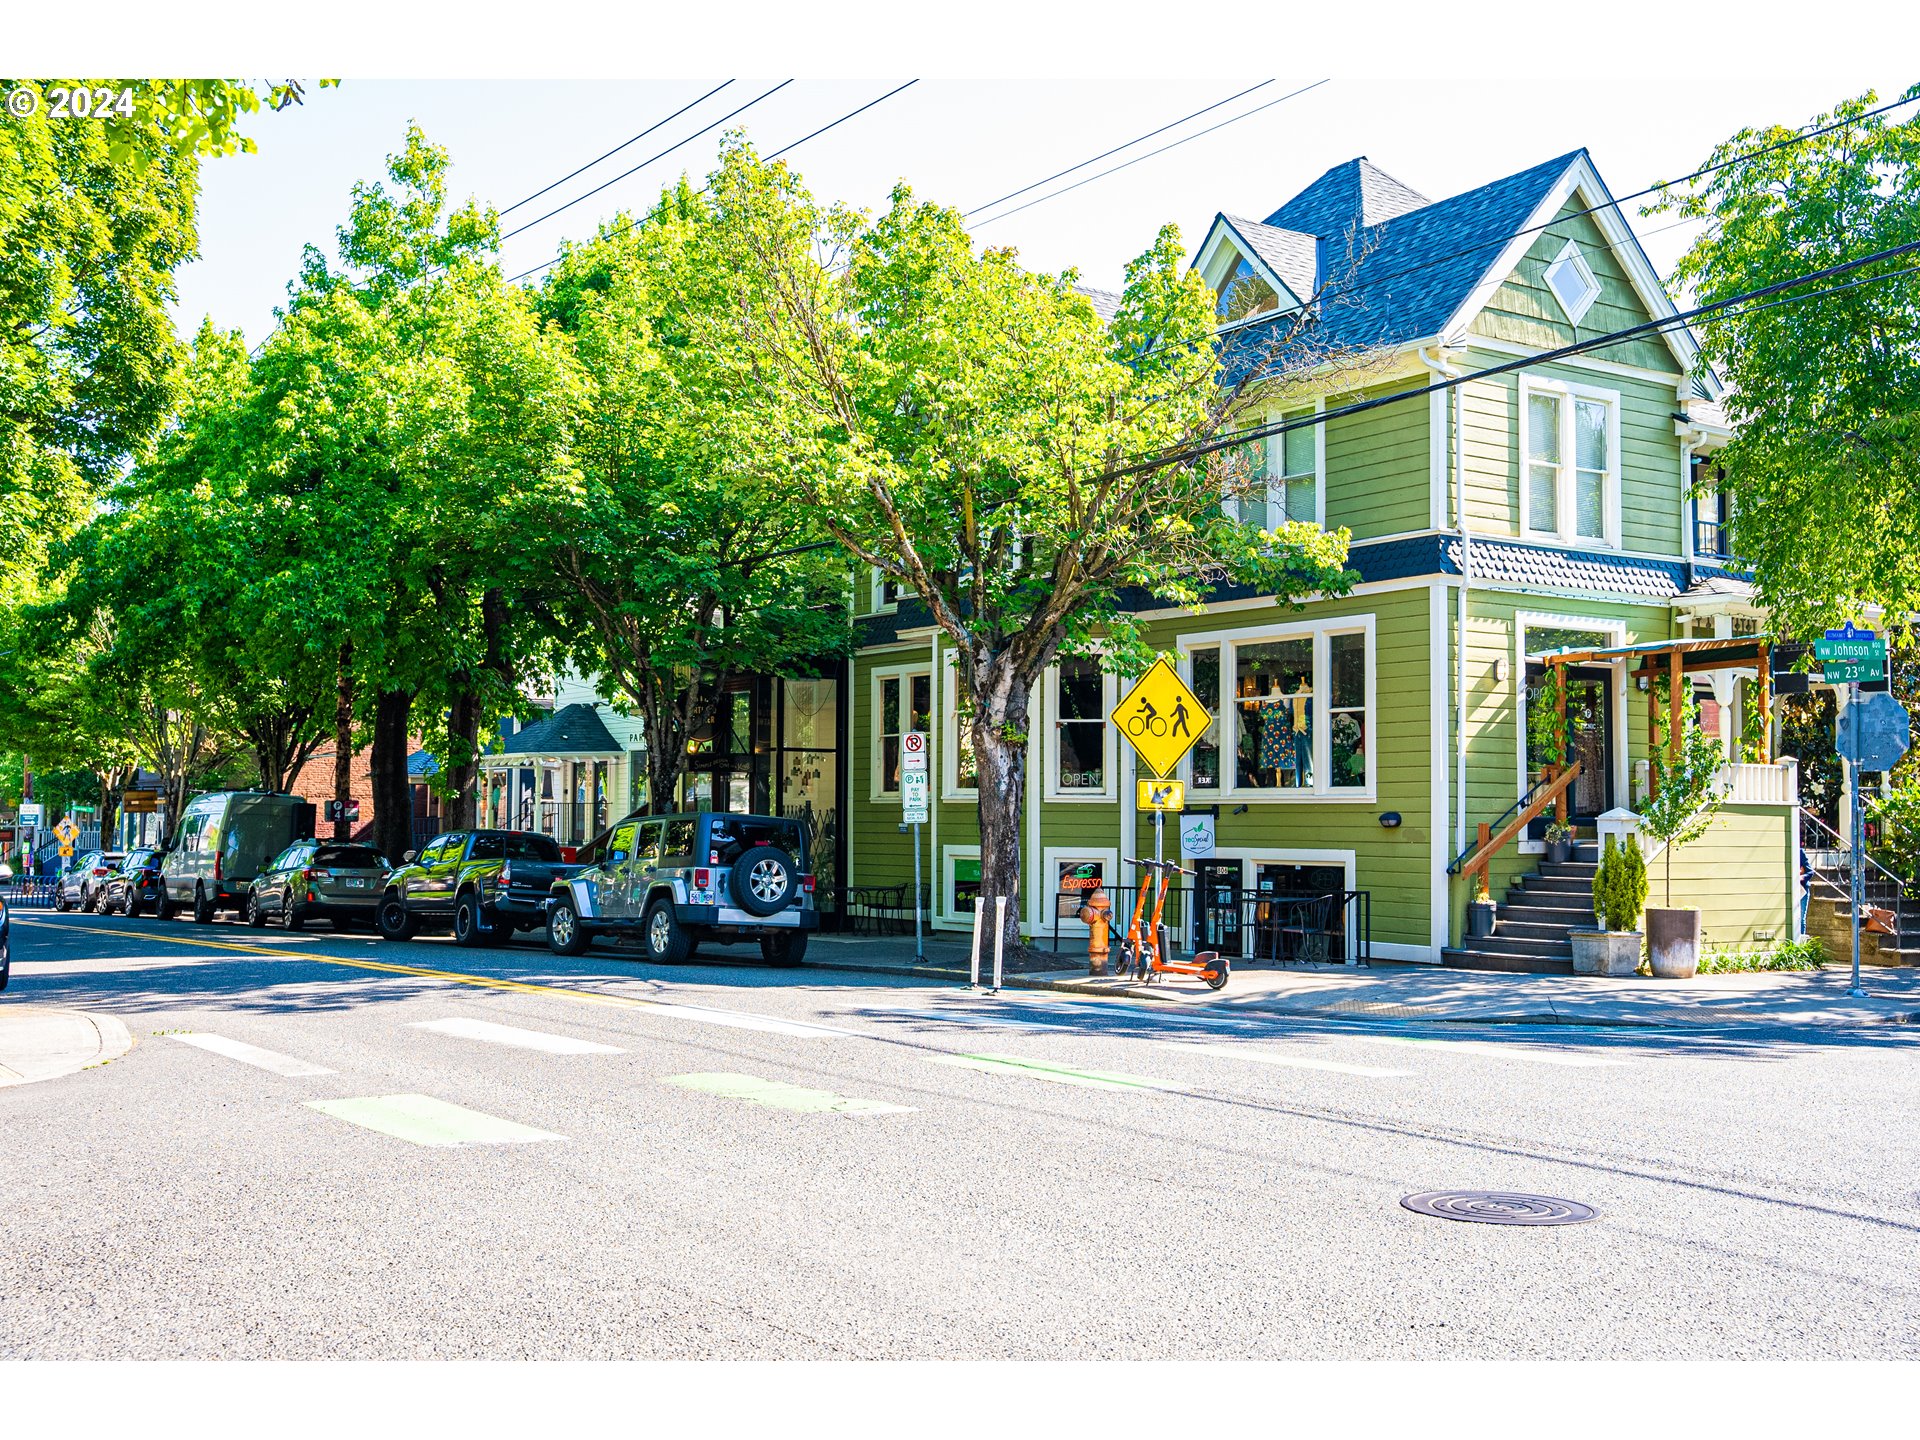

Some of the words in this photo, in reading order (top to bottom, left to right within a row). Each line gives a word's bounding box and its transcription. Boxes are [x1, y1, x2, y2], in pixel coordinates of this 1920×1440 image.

[1821, 647, 1830, 655] NW
[1834, 643, 1869, 656] Johnson
[1827, 671, 1840, 680] NW
[1845, 665, 1865, 678] 23rd
[1870, 668, 1880, 676] Av
[1062, 773, 1099, 786] OPEN
[334, 811, 341, 819] 4
[1062, 875, 1103, 891] Espresso
